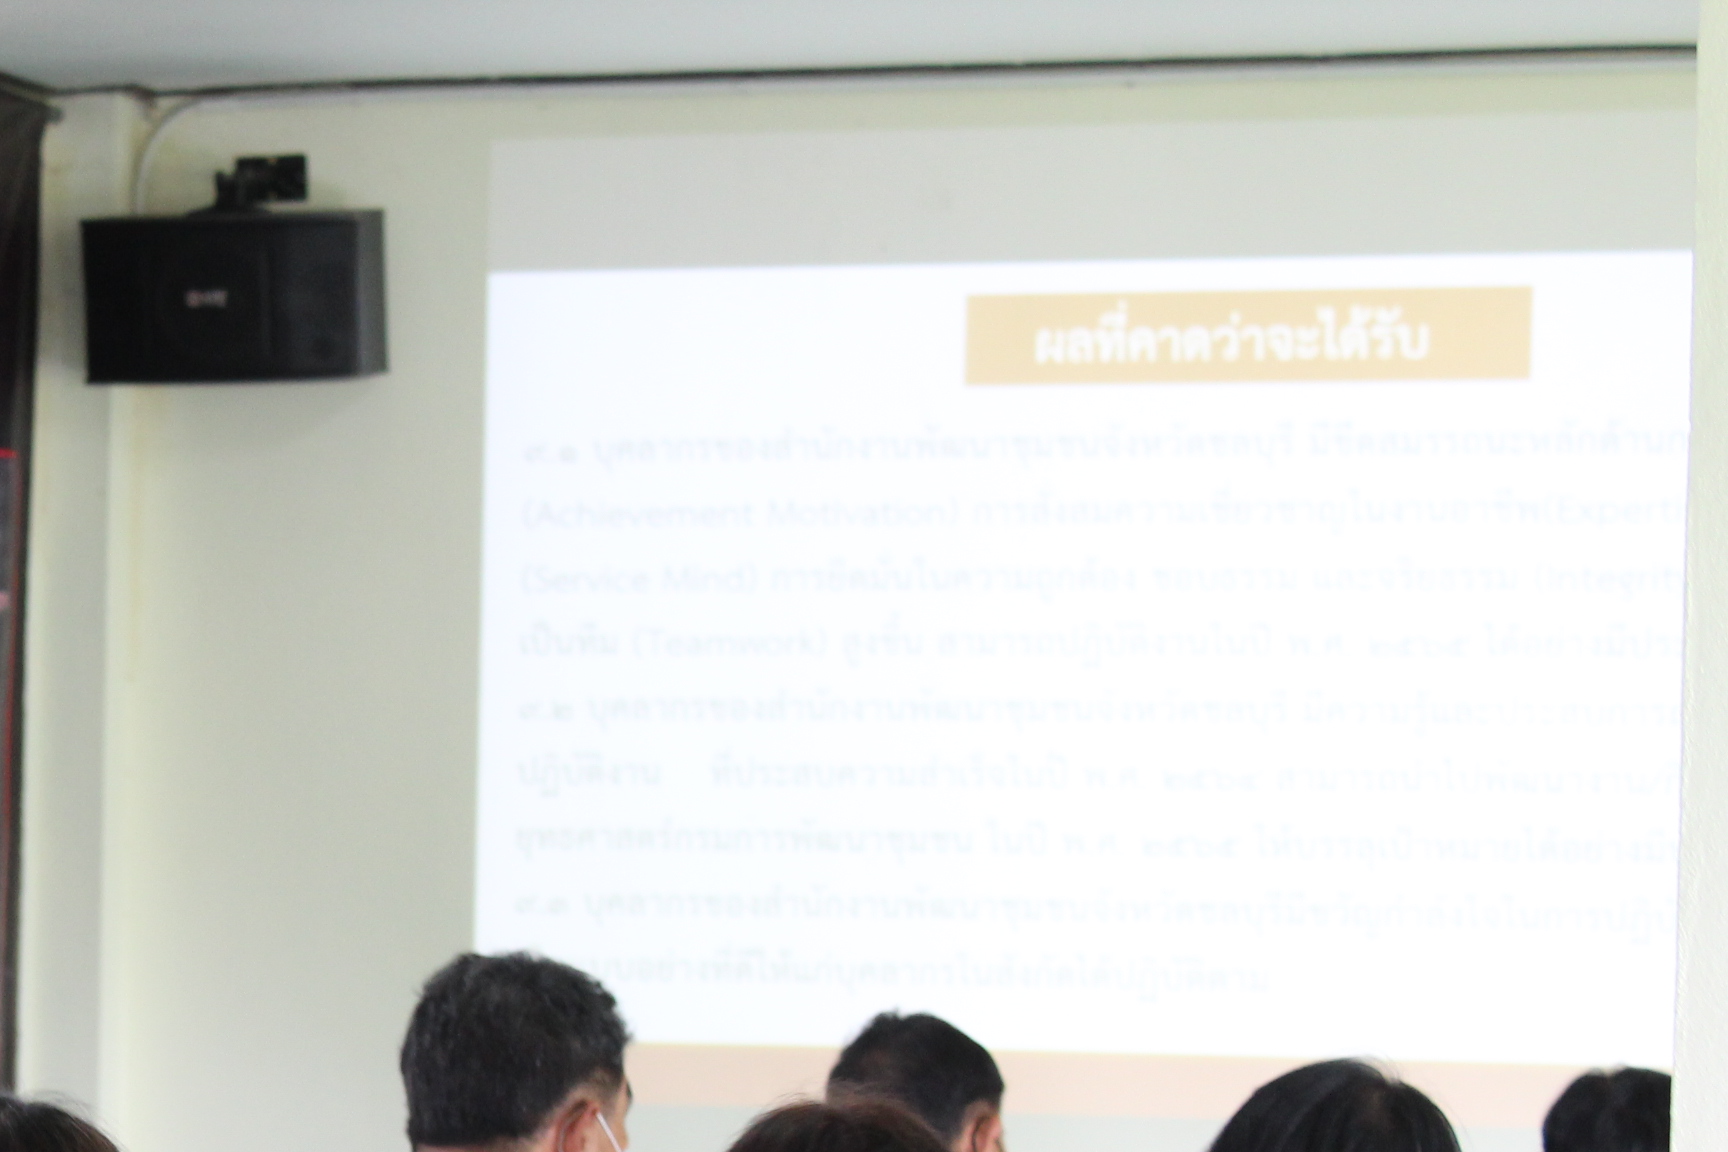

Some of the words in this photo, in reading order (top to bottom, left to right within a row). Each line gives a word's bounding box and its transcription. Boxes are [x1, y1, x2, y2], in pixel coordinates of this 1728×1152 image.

[1034, 301, 1432, 364] ผลที่คาดว่าจะได้รับ
